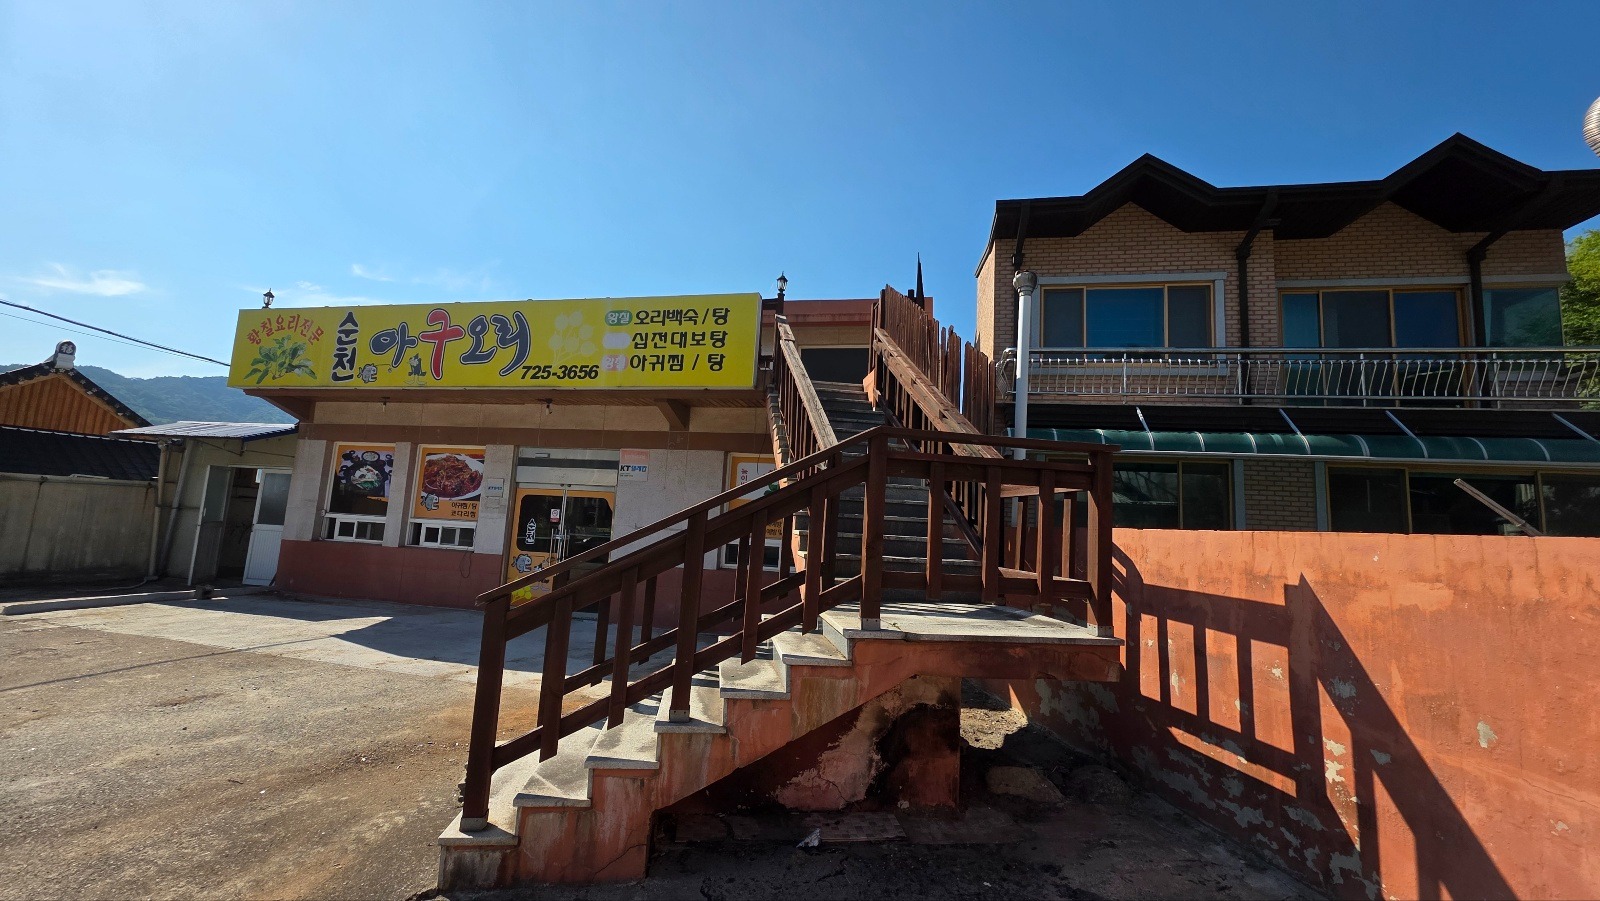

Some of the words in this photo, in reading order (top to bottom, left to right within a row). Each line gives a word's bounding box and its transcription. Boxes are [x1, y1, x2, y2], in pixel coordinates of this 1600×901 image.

[331, 311, 359, 382] 순천
[632, 330, 728, 350] 십전대보탕
[520, 365, 600, 380] 725-3656
[630, 354, 684, 372] 아귀찜
